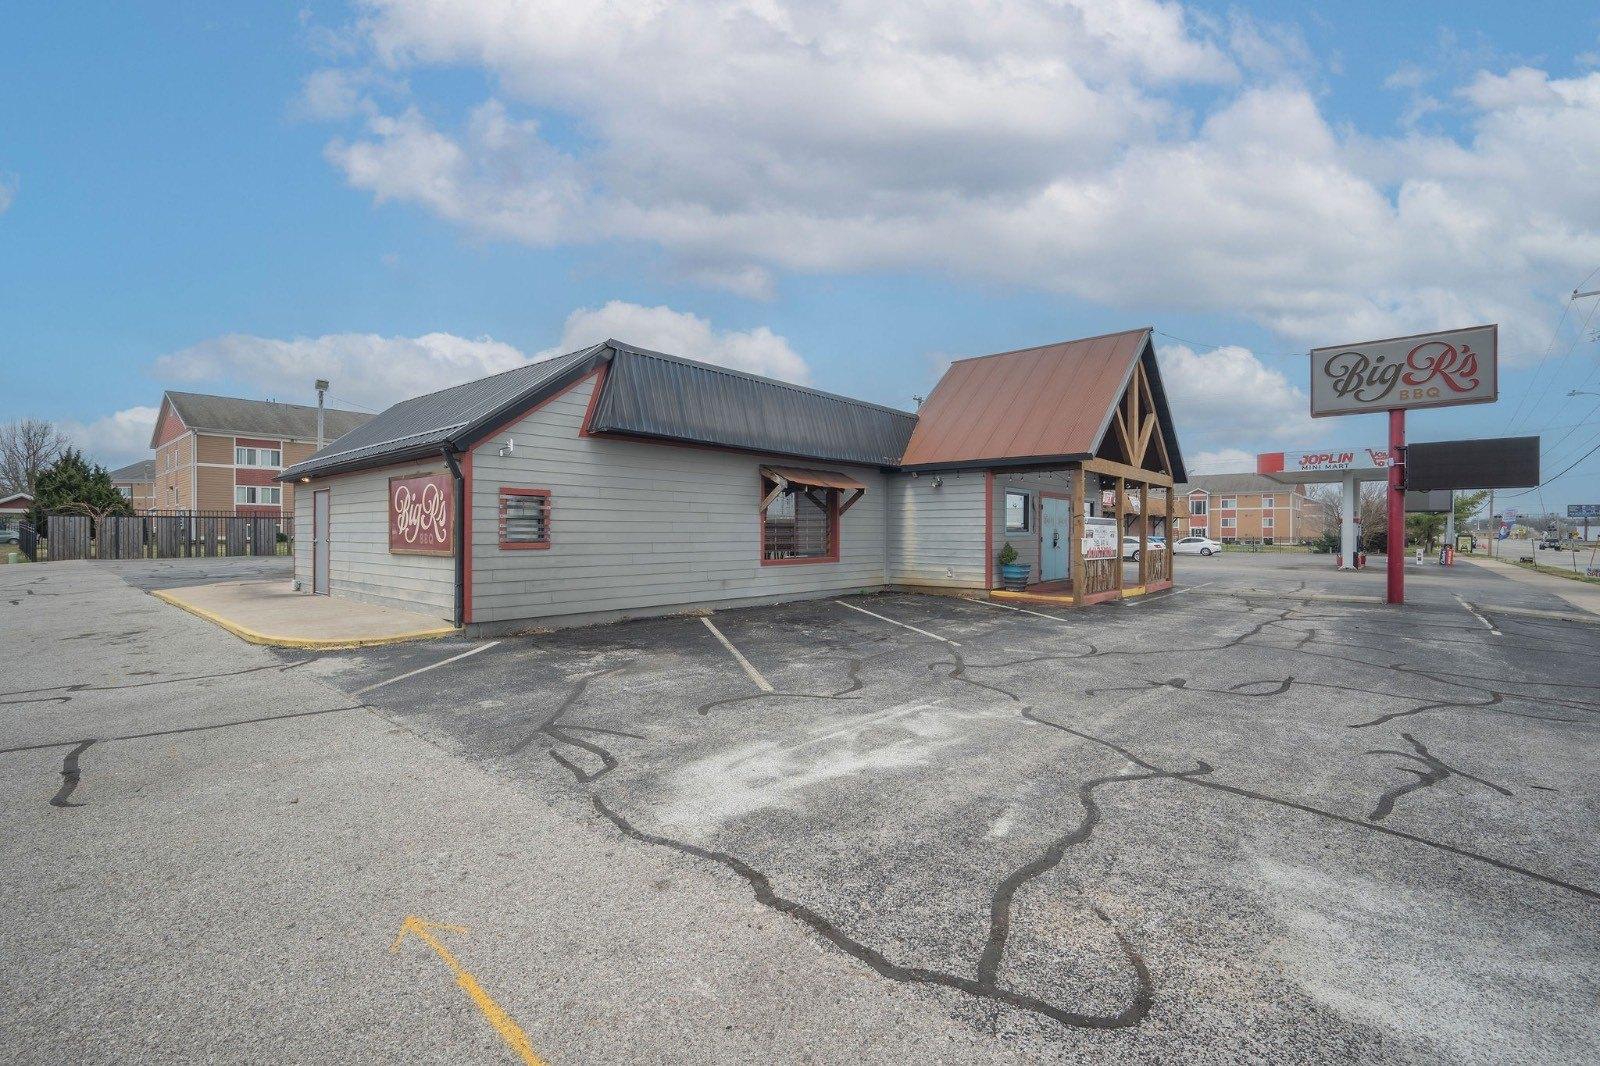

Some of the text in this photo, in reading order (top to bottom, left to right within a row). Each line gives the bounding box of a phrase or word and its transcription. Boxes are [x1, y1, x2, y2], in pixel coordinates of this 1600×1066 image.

[1324, 341, 1480, 402] Big R's
[1400, 387, 1441, 400] BBQ
[1299, 453, 1354, 465] JOPLIN
[394, 483, 447, 543] Big R's
